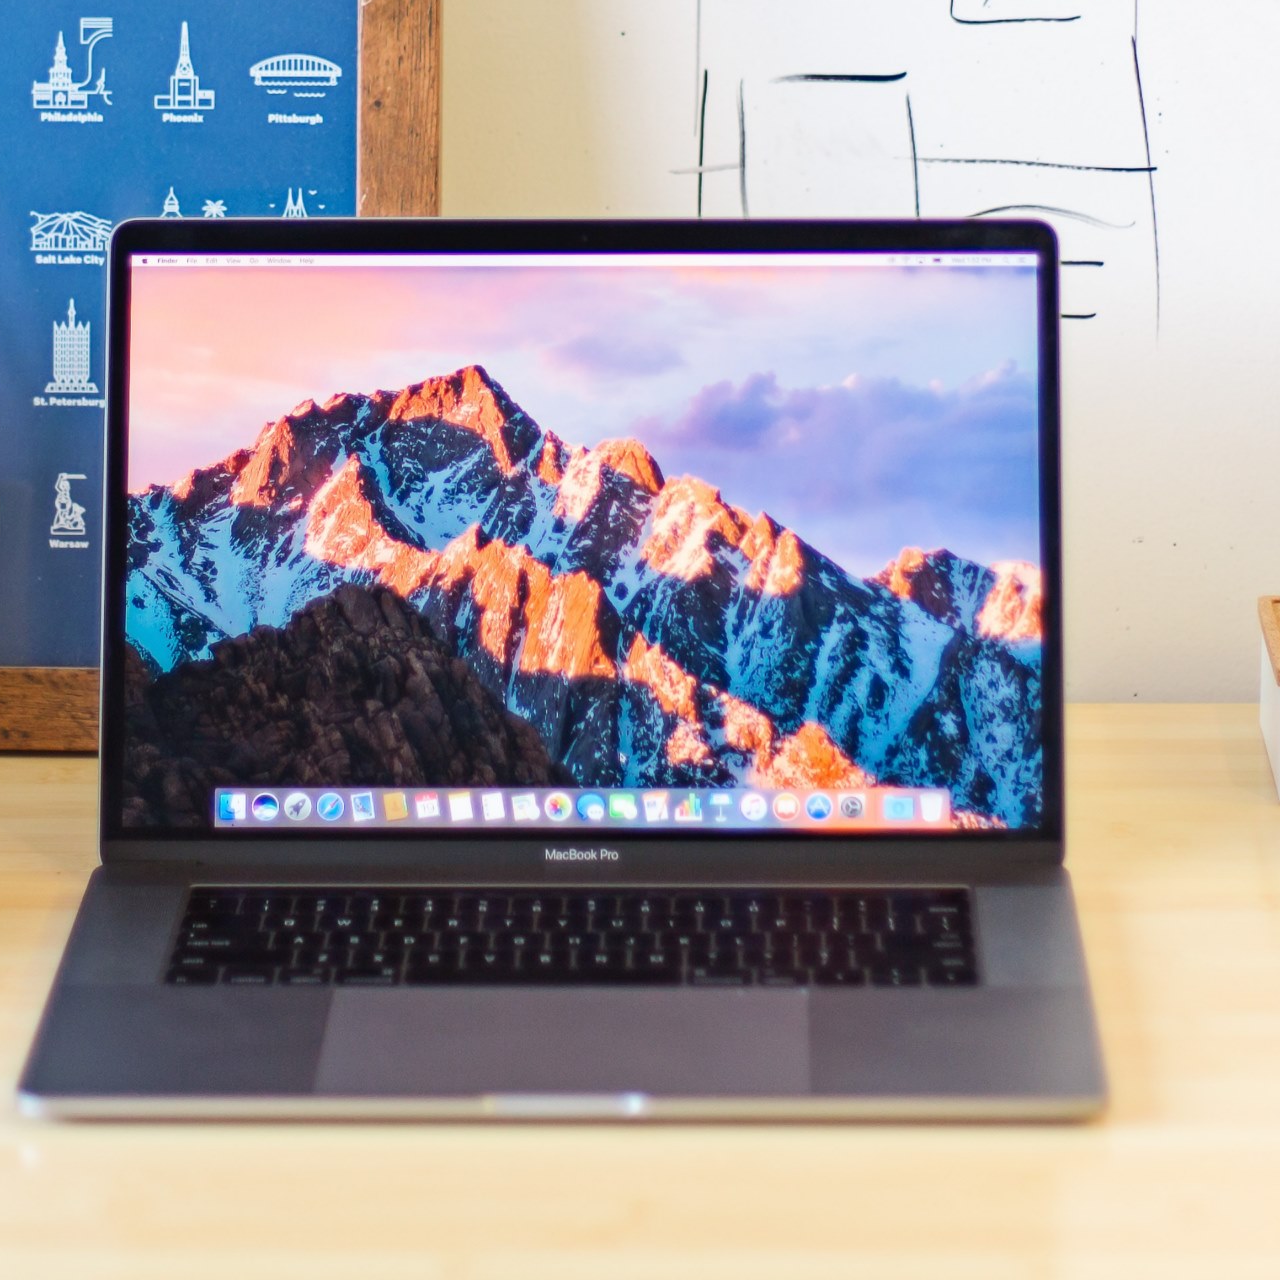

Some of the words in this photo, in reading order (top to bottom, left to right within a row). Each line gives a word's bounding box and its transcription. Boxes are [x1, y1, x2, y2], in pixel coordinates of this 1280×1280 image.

[41, 112, 103, 123] Philadelphia
[162, 113, 203, 122] Phoenix
[268, 114, 323, 125] Pittsburgh
[35, 254, 56, 264] Salt
[58, 254, 82, 264] Lake
[83, 254, 106, 266] City
[157, 257, 178, 265] Finder
[186, 257, 198, 265] File
[205, 257, 218, 265] Edit
[226, 257, 241, 265] View
[267, 257, 292, 265] Window
[299, 257, 315, 266] Help
[33, 397, 48, 406] St.
[49, 539, 89, 548] Warsaw
[545, 849, 597, 861] MacBook
[600, 849, 619, 861] Pro
